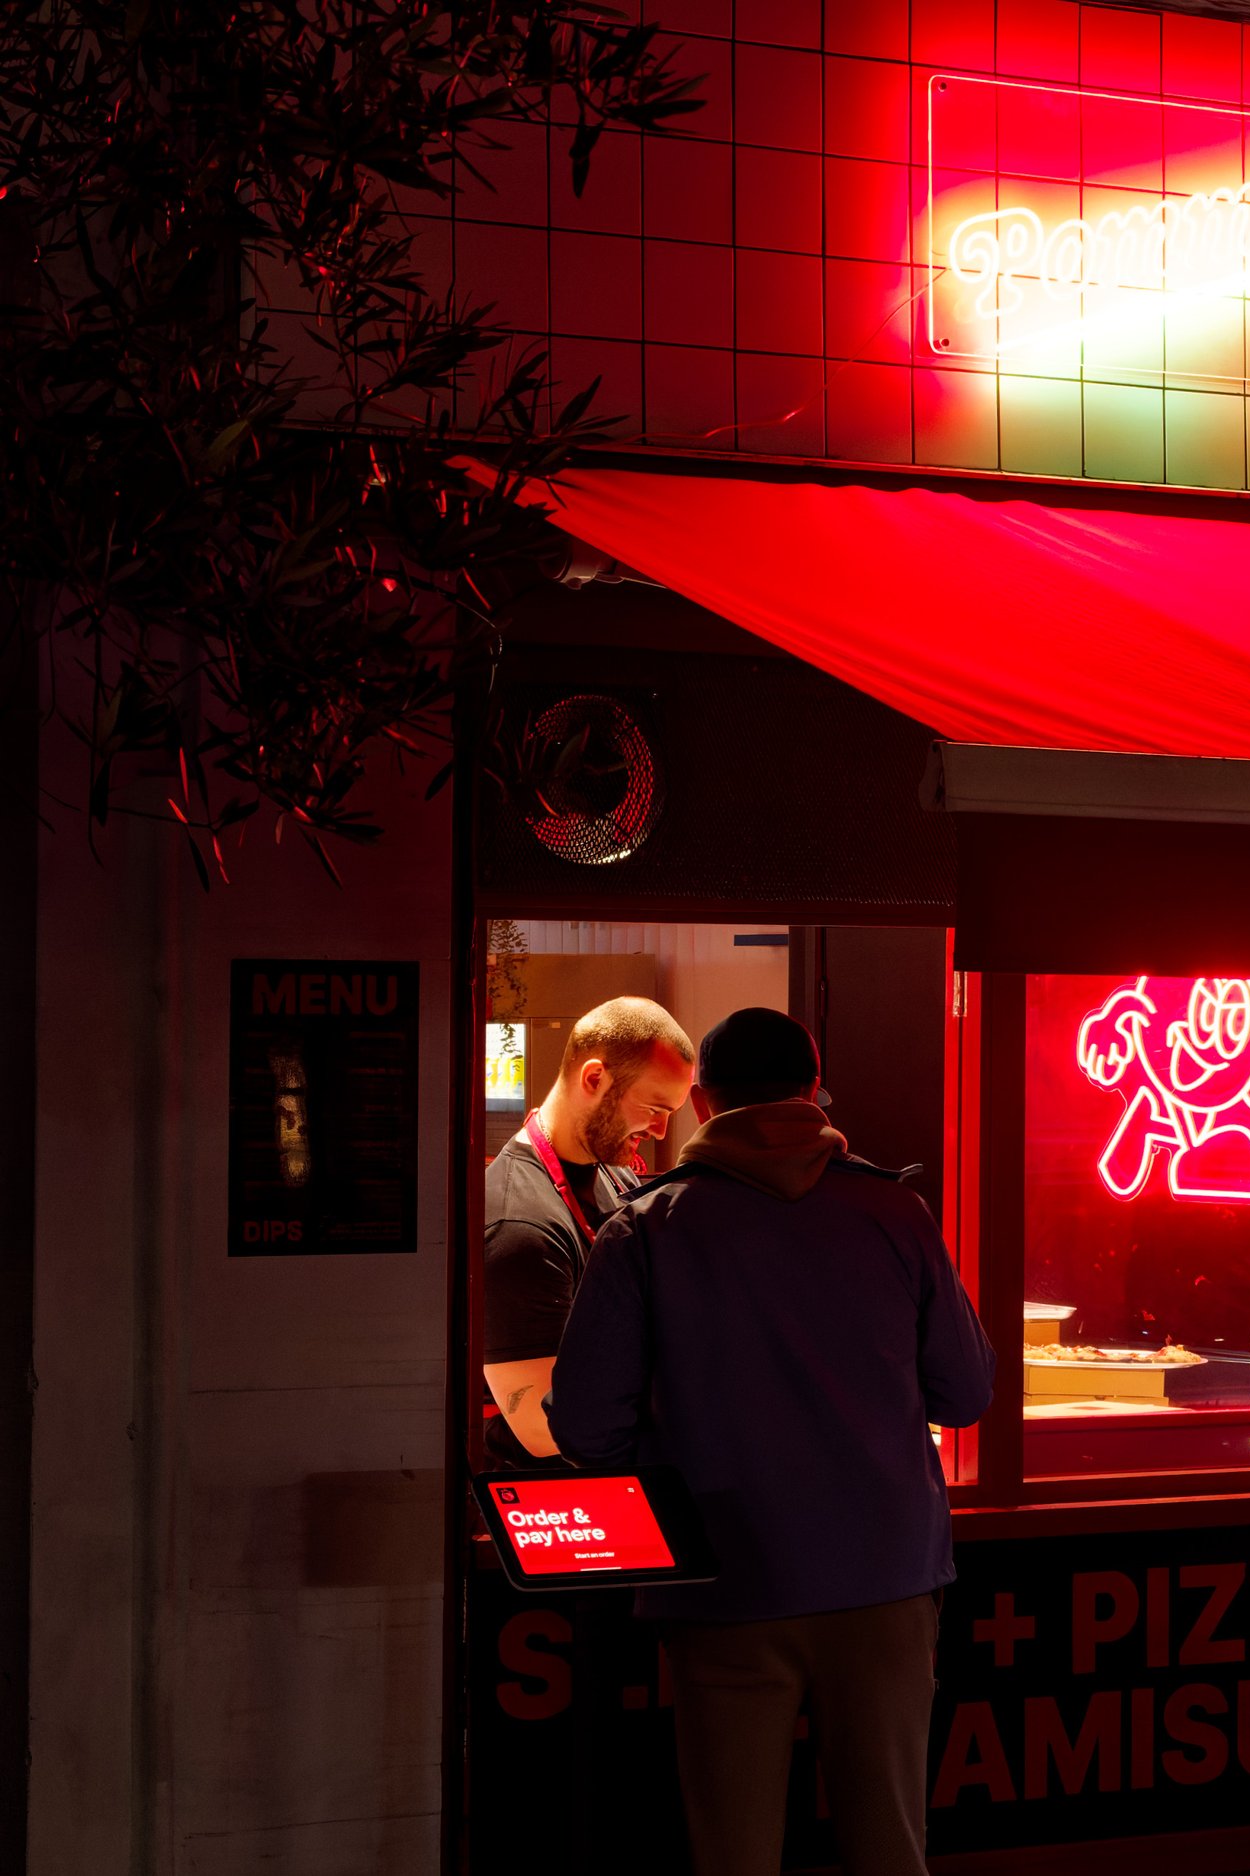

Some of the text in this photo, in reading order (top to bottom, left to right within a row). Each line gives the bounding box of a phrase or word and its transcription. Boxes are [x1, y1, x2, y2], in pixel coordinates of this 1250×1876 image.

[252, 973, 398, 1016] MENU
[243, 1219, 303, 1243] DIPS
[507, 1507, 592, 1528] Order &
[514, 1525, 606, 1548] pay here
